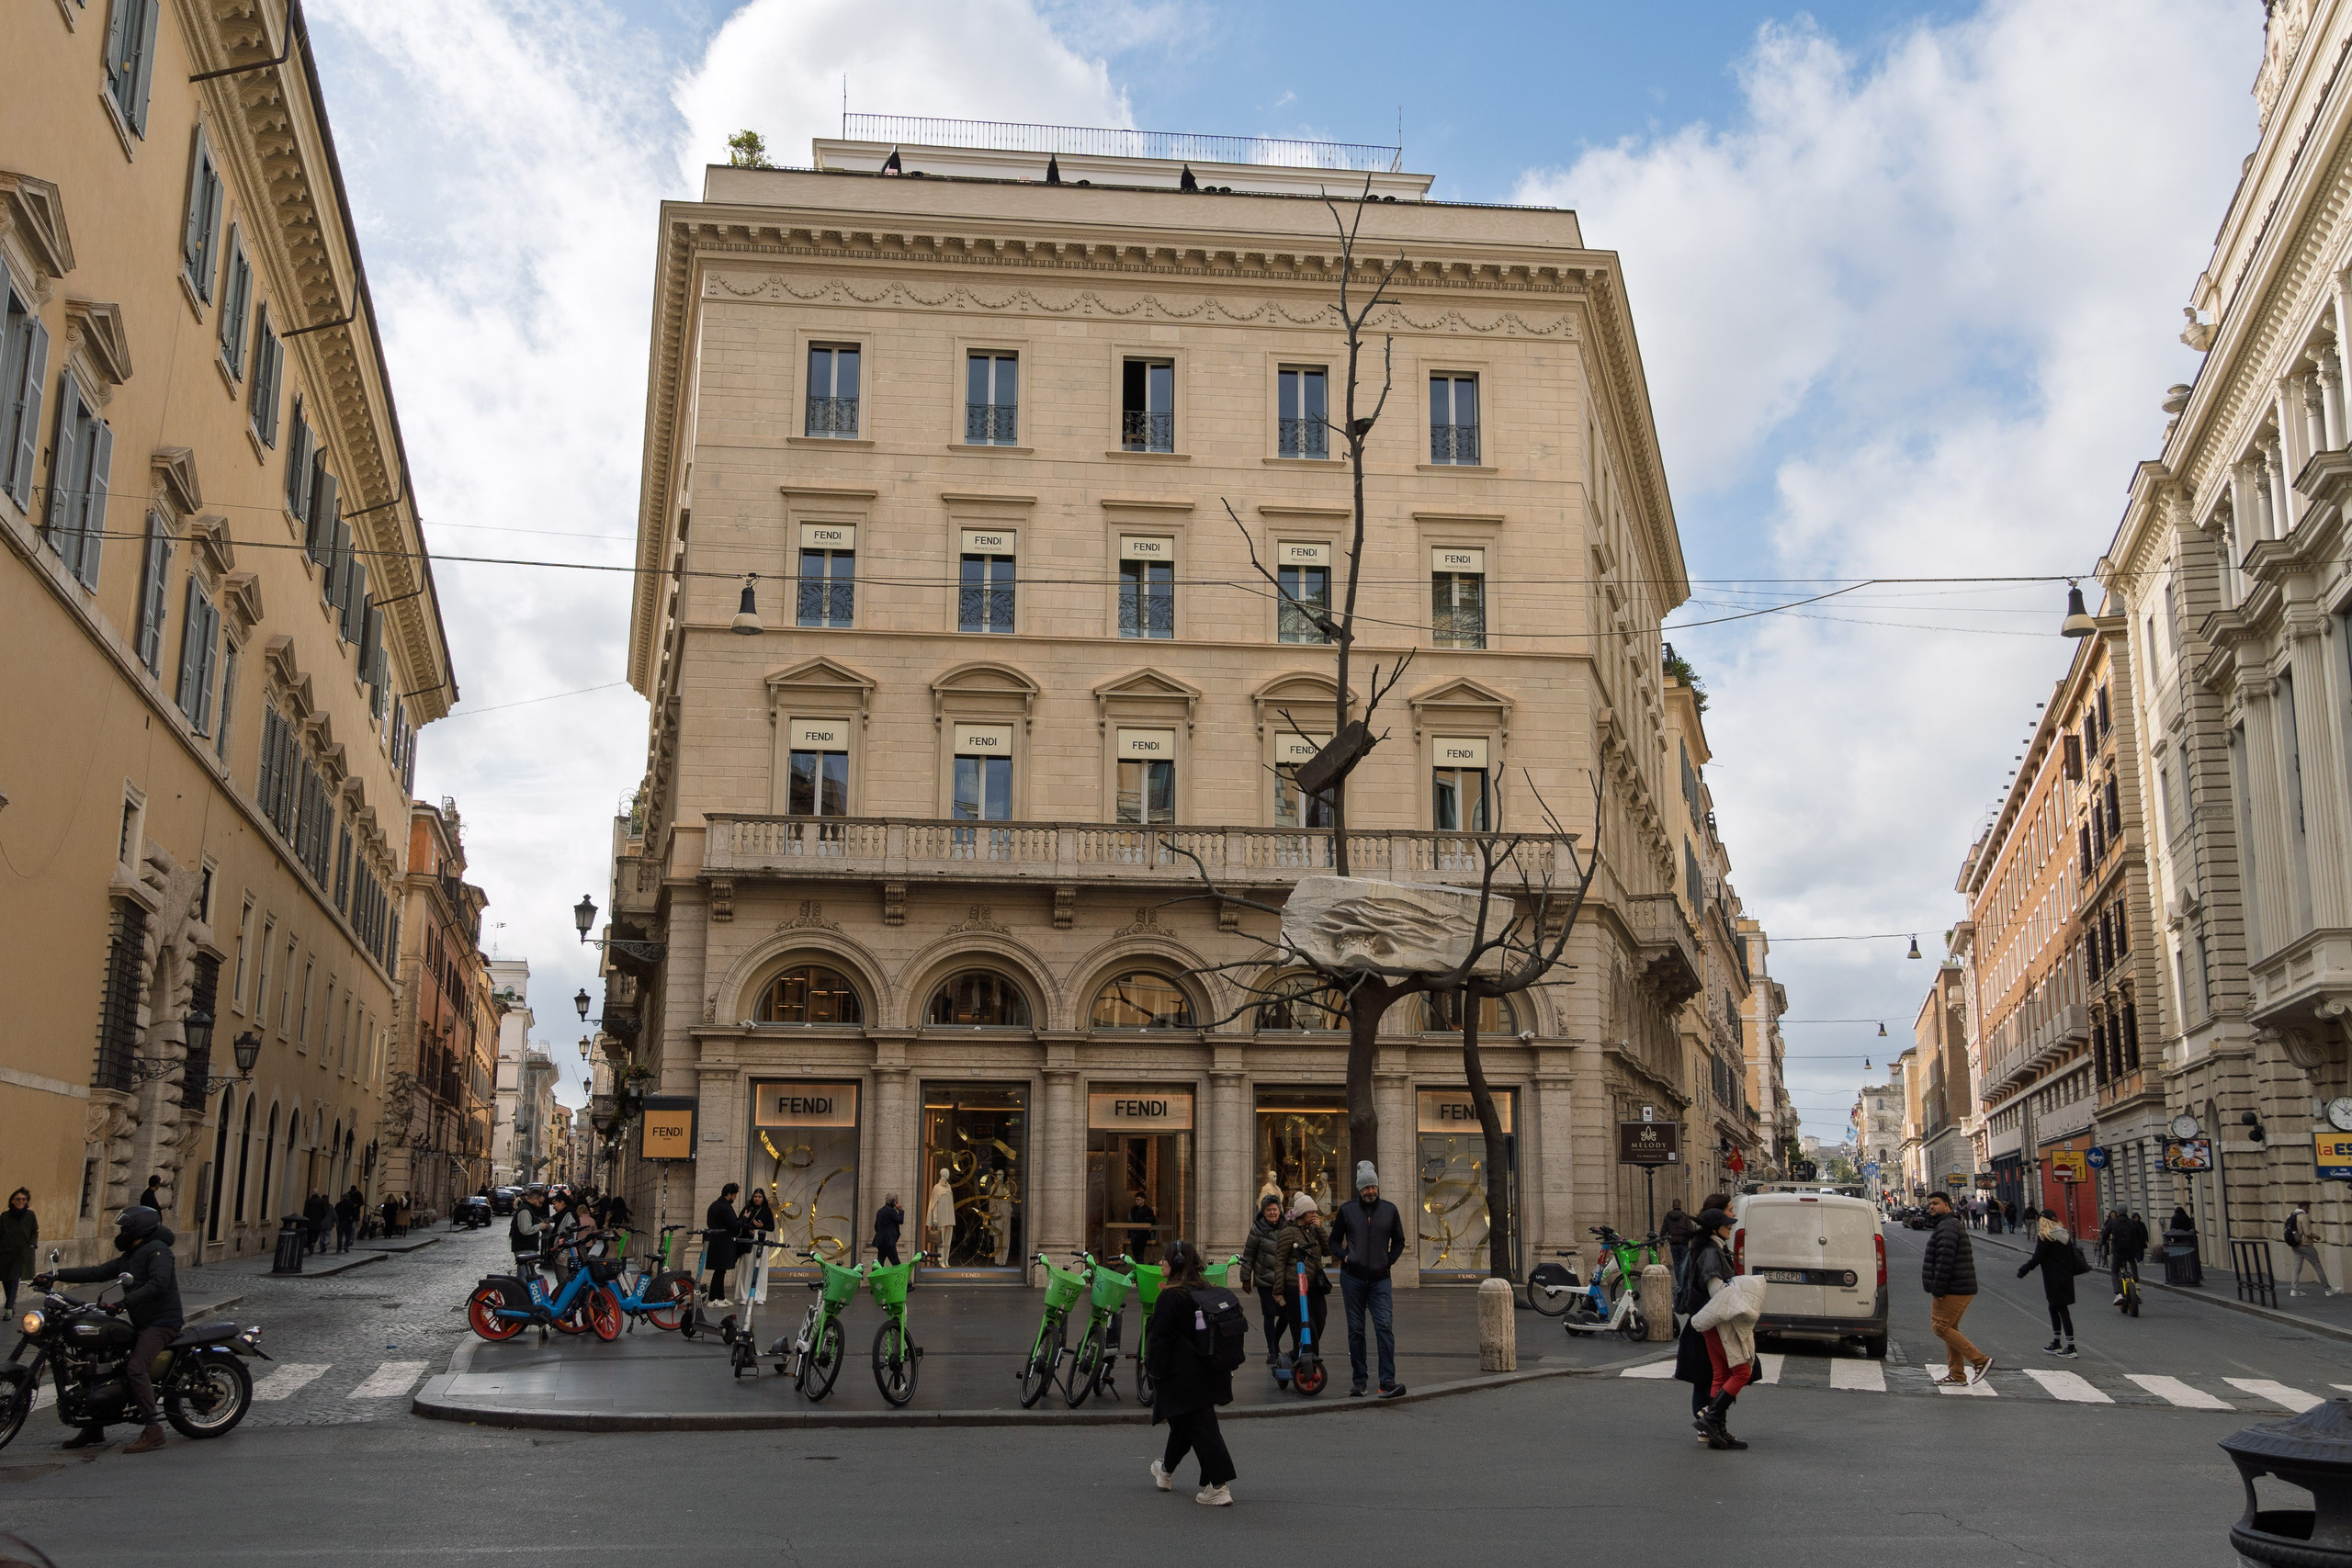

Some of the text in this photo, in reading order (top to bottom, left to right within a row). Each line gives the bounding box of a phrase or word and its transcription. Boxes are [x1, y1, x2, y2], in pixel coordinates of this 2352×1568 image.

[814, 531, 842, 539] FENDI
[975, 536, 1001, 545] FENDI
[1134, 543, 1160, 551] FENDI
[1291, 547, 1317, 557] FENDI
[1444, 555, 1471, 563] FENDI
[805, 732, 833, 741] FENDI
[969, 737, 997, 746] FENDI
[1132, 741, 1159, 750] FENDI
[1447, 750, 1474, 758] FENDI
[778, 1097, 832, 1114] FENDI
[1114, 1100, 1167, 1116] FENDI
[1441, 1104, 1479, 1120] FEN
[652, 1126, 683, 1136] FENDI
[637, 1277, 650, 1296] dott
[529, 1282, 542, 1304] dott
